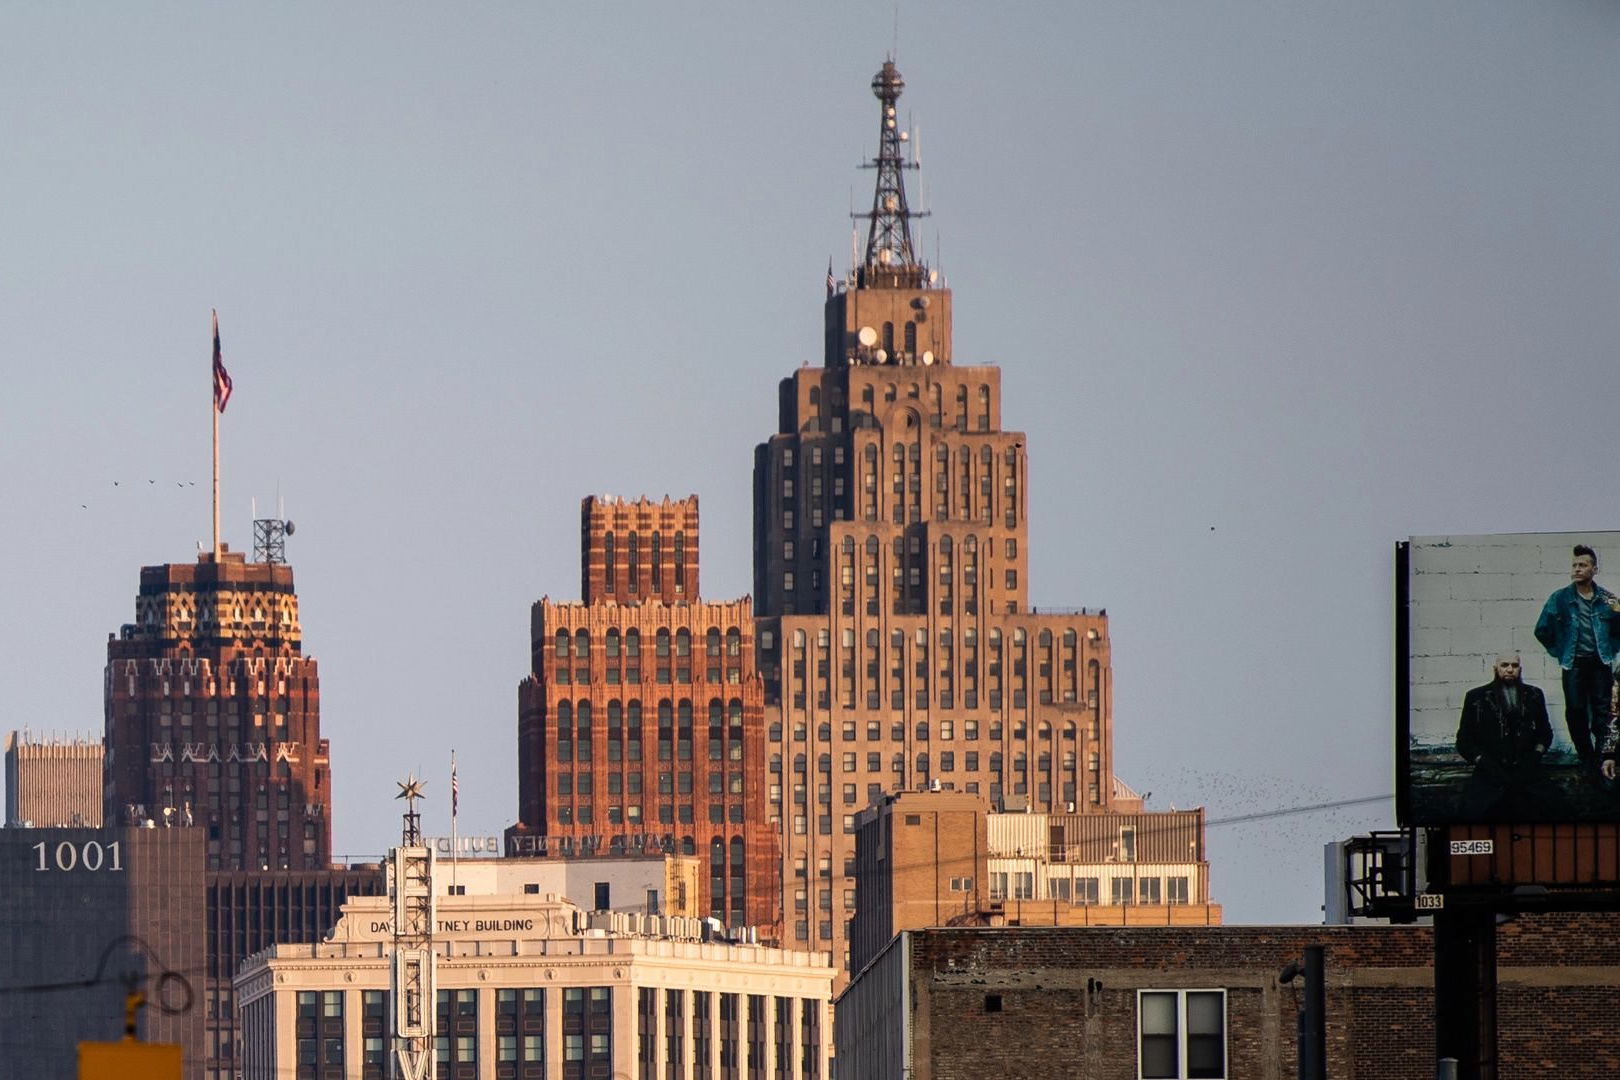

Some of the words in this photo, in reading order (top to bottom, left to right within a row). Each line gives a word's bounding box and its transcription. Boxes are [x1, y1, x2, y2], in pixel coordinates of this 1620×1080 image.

[1450, 841, 1492, 854] 95469
[32, 840, 124, 872] 1001
[1415, 895, 1443, 908] 1033
[475, 919, 533, 931] BUILDING
